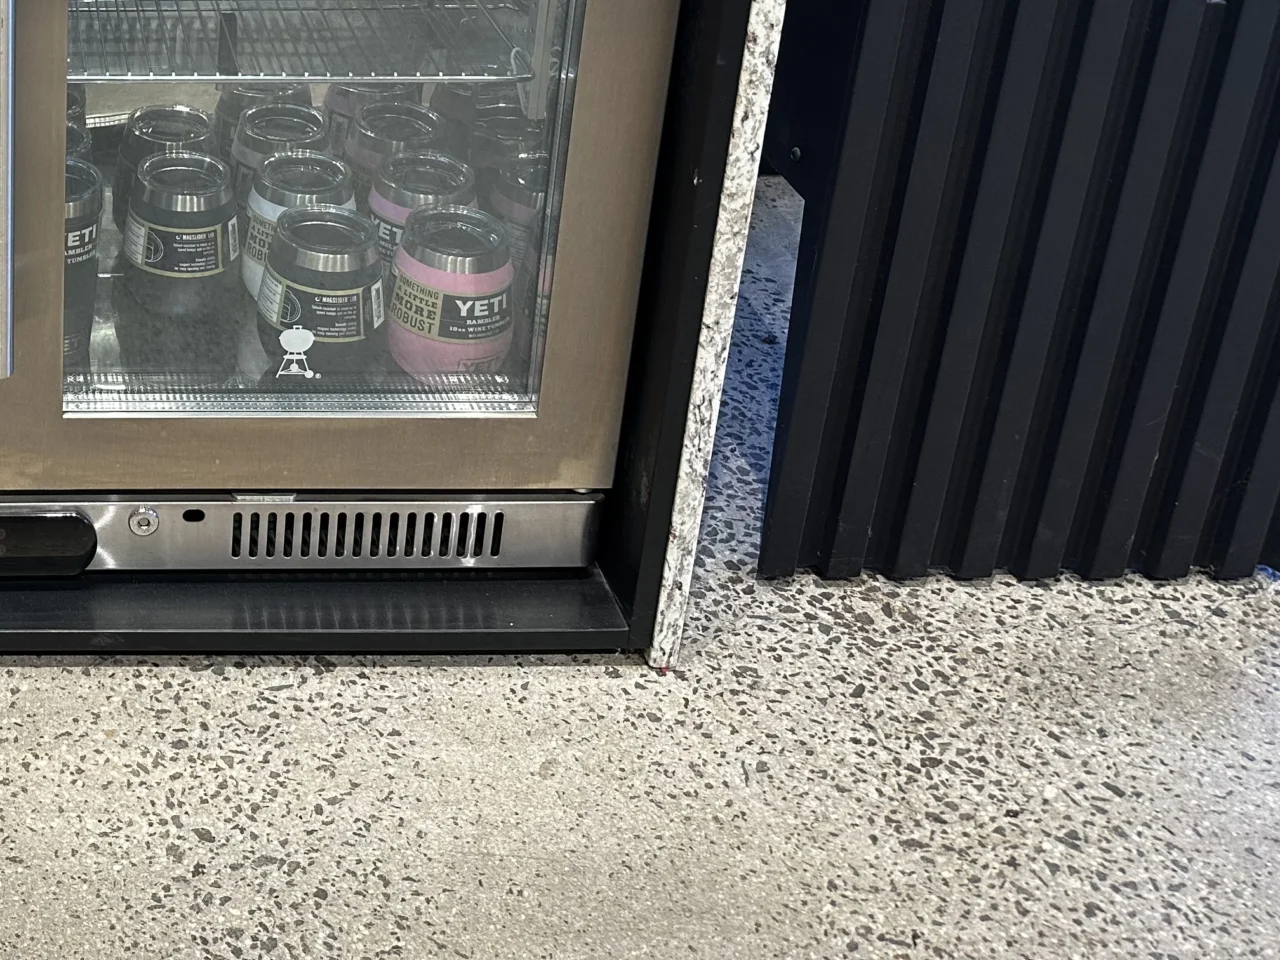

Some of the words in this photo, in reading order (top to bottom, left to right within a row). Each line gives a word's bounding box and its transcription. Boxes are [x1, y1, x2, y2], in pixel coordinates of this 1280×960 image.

[65, 224, 97, 247] ETI
[67, 249, 96, 264] TUMBLER
[400, 274, 439, 300] SOMETHING
[404, 288, 438, 309] LITTLE
[394, 292, 437, 321] MORE
[455, 293, 507, 317] YETI
[391, 303, 435, 334] ROBUST
[466, 315, 500, 325] RAMBLER
